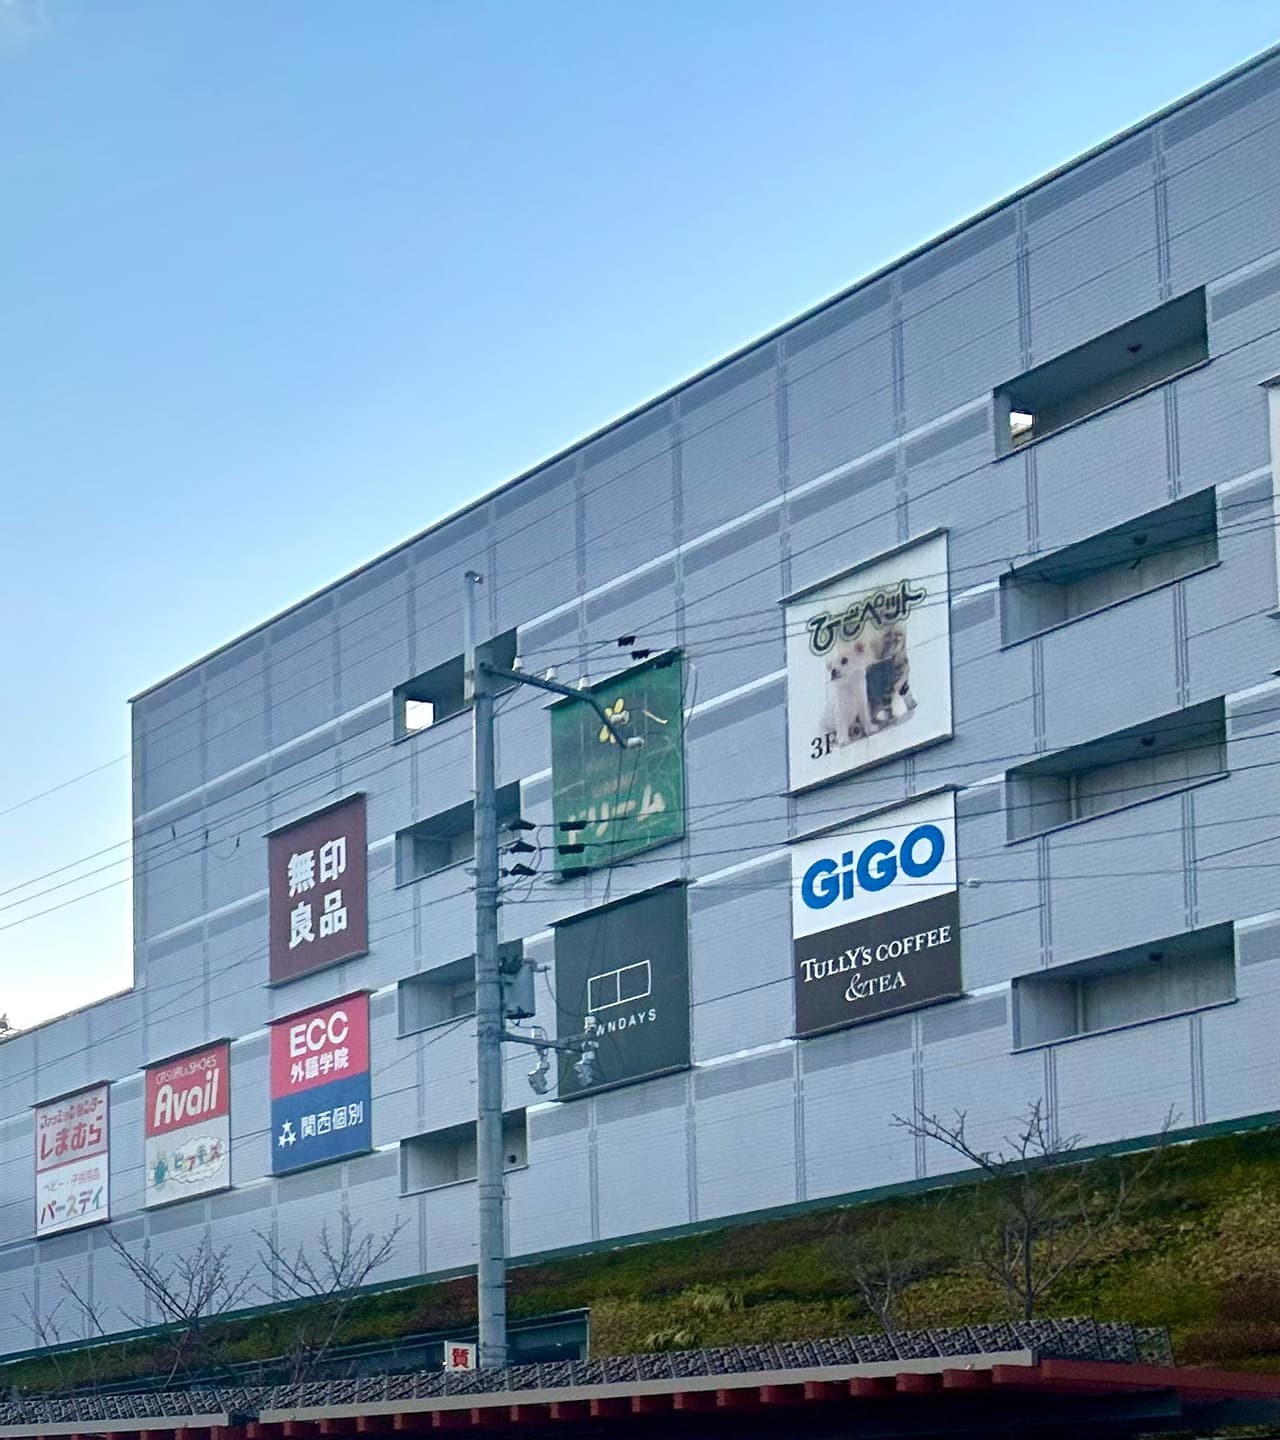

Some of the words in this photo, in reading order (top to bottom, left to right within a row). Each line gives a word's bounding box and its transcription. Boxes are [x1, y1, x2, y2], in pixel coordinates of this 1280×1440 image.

[810, 731, 838, 759] 3F
[801, 824, 945, 909] GiGO
[875, 925, 952, 962] COFFEE
[289, 1010, 349, 1058] ECC
[290, 1046, 350, 1084] 外語学院
[153, 1067, 220, 1128] Avail
[40, 1115, 104, 1161] しまむら
[300, 1100, 363, 1139] 関西個別
